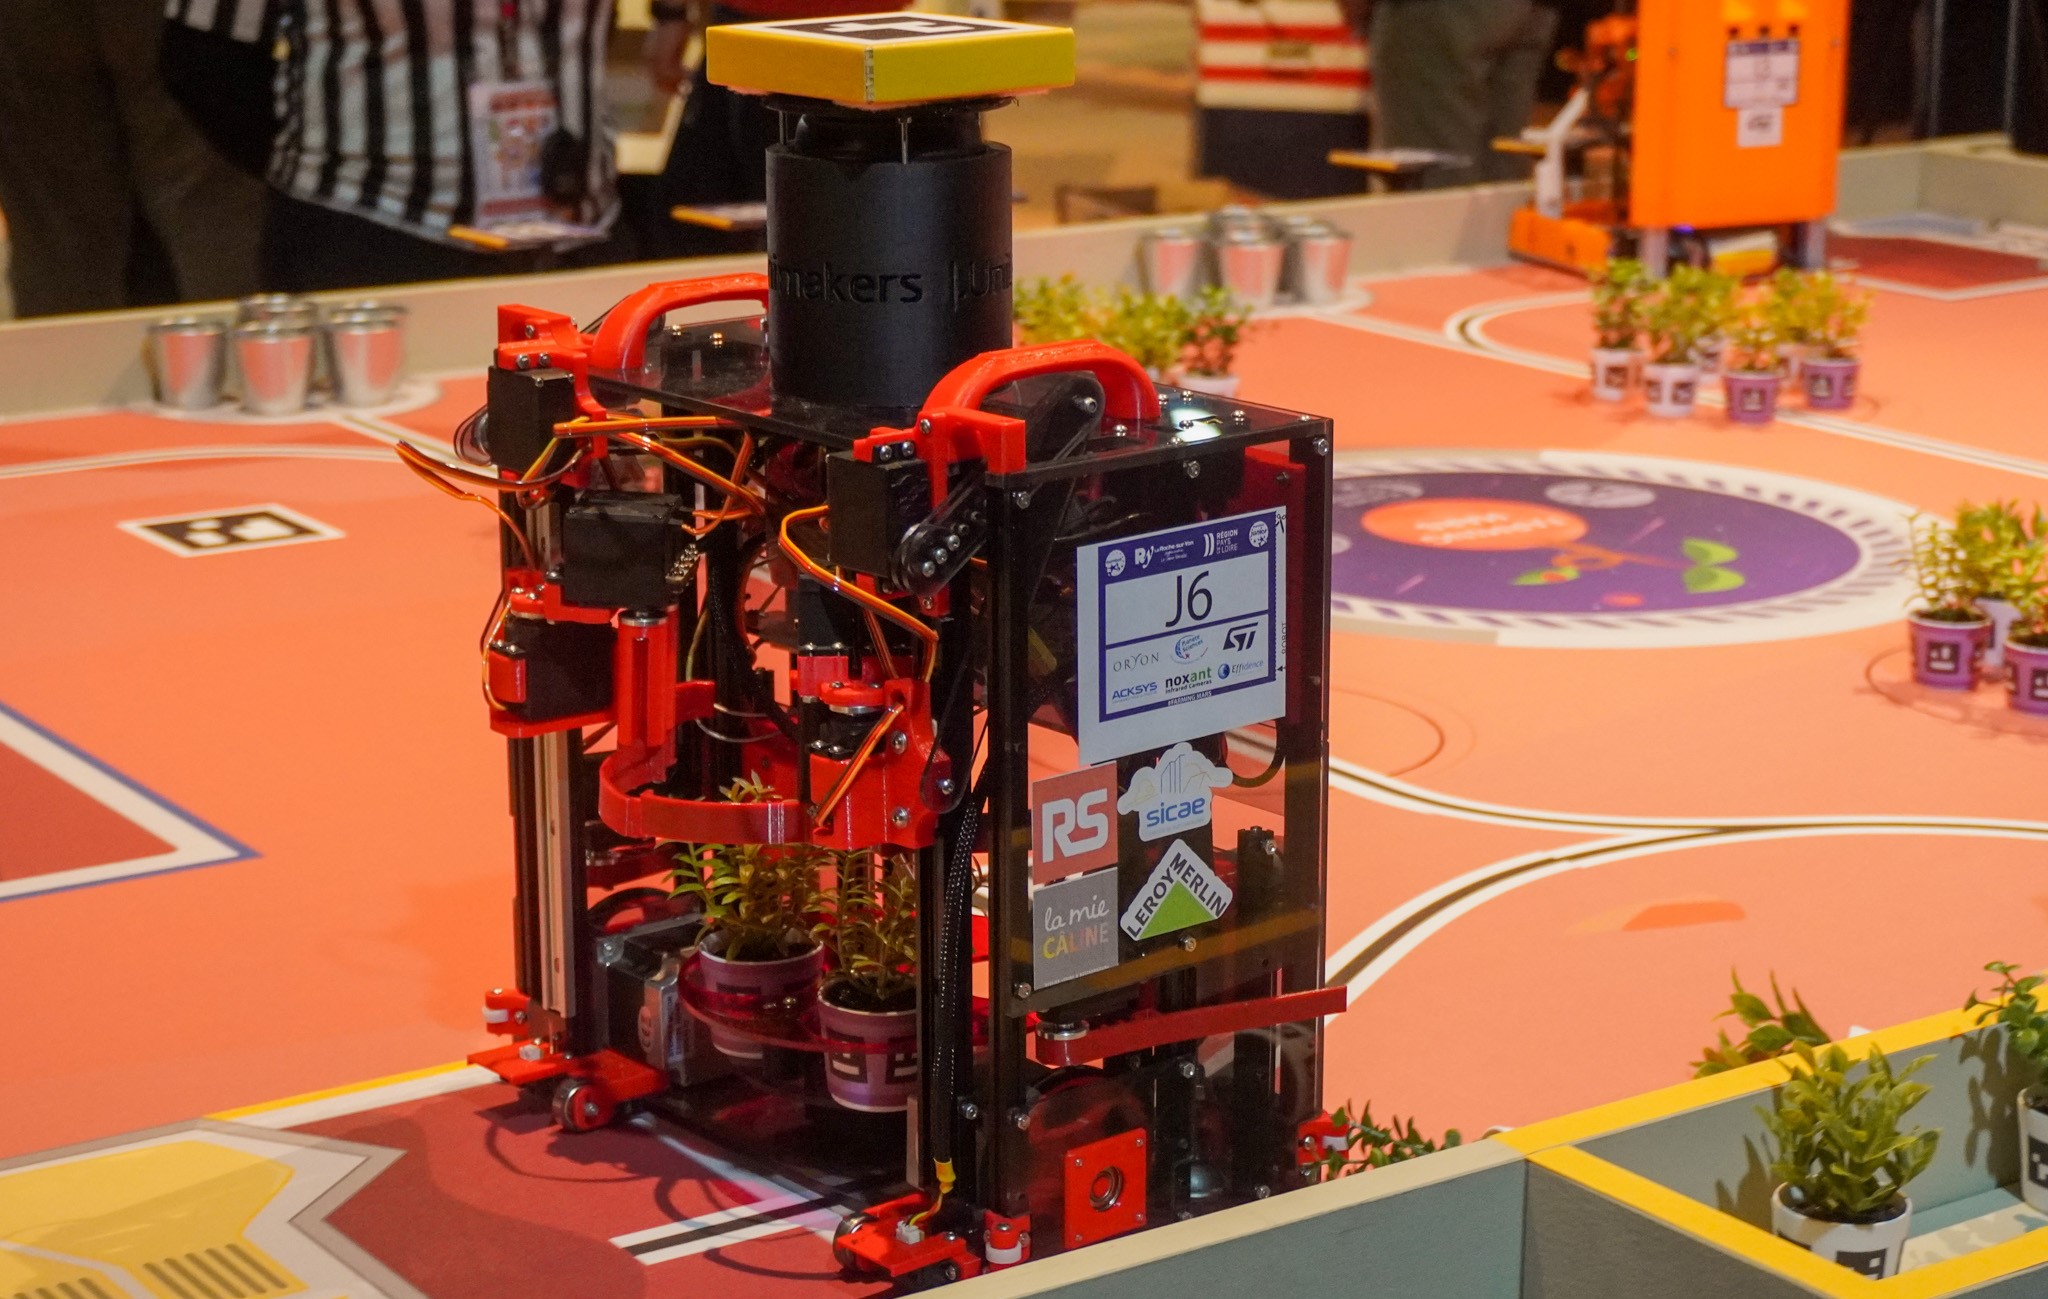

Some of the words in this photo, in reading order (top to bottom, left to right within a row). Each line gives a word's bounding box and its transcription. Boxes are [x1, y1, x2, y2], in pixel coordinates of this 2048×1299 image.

[1216, 537, 1231, 546] PAYS
[1217, 528, 1238, 539] RÉGION
[1221, 543, 1238, 554] LOIRE
[1165, 570, 1213, 628] J6
[1223, 621, 1259, 652] ST
[1113, 652, 1160, 672] ORYON
[1165, 666, 1212, 688] noxant
[1112, 681, 1158, 700] ACKSYS
[1042, 788, 1109, 863] RS
[1146, 797, 1205, 828] sicae
[1127, 866, 1175, 938] LEROY
[1169, 852, 1227, 918] MERLIN
[1045, 906, 1065, 932] la
[1069, 894, 1110, 926] mie
